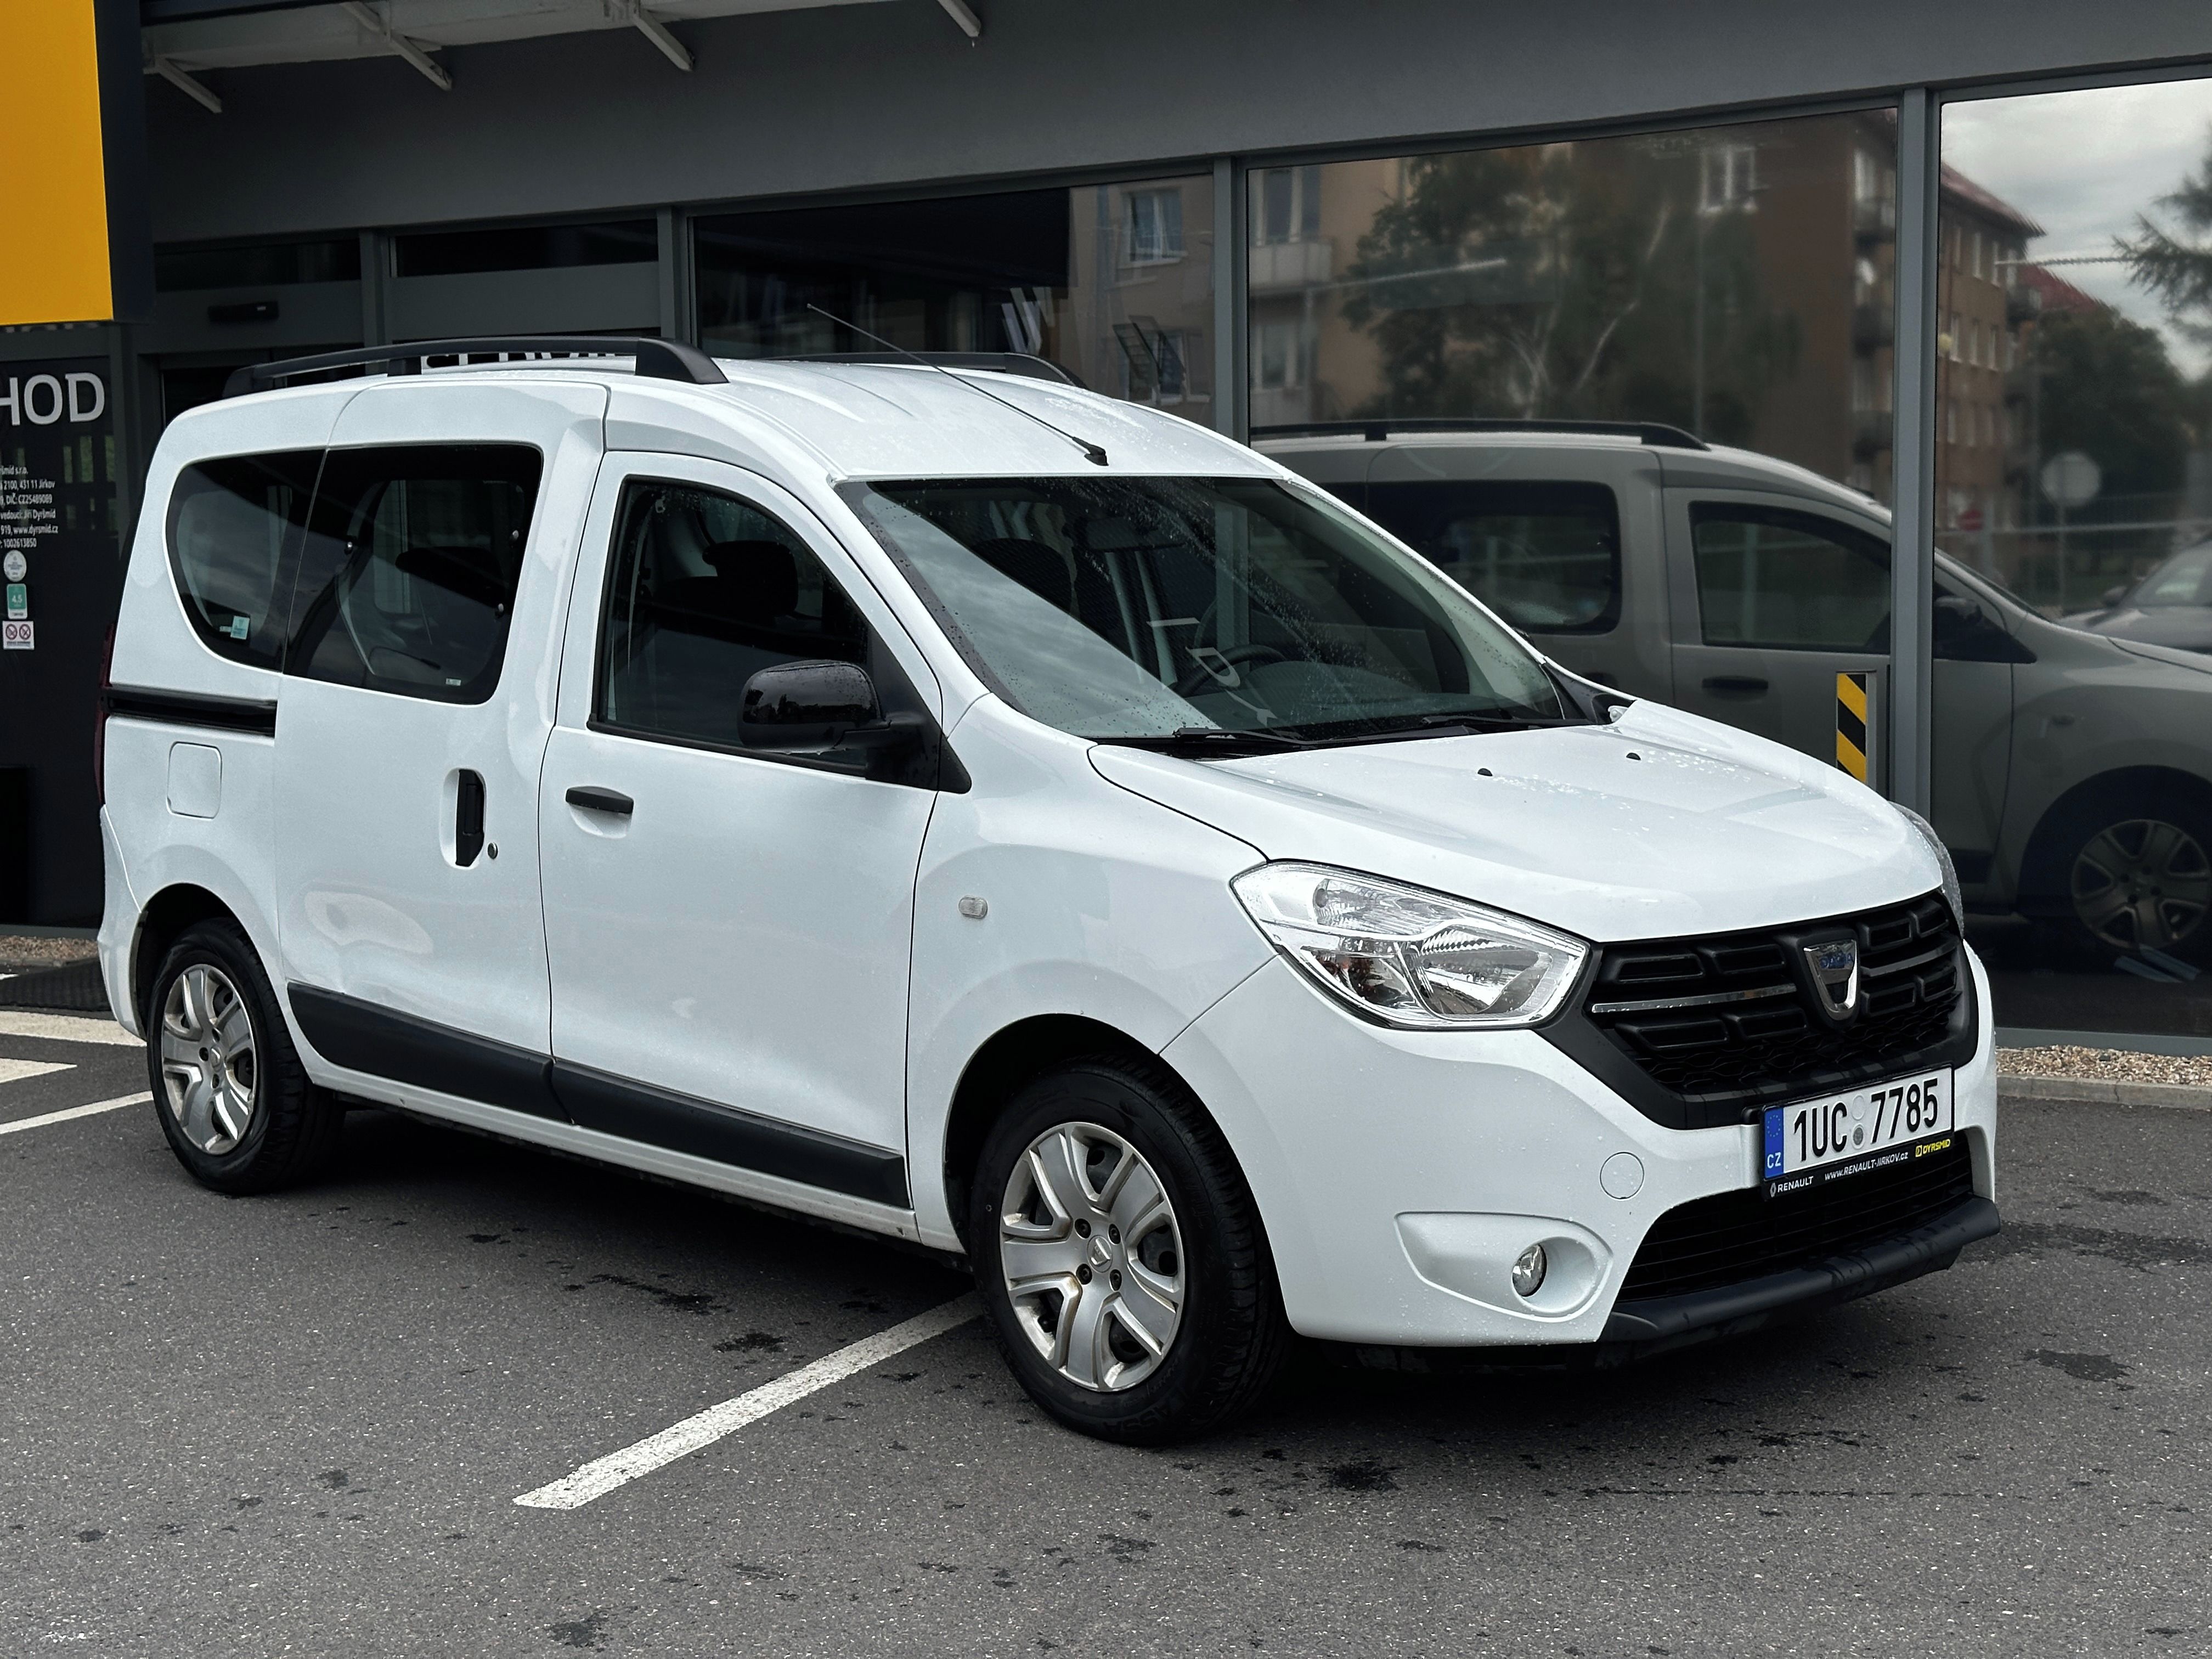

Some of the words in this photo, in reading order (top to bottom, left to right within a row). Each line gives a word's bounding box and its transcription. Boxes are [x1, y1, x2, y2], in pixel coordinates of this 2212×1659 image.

[19, 479, 30, 490] 431
[31, 479, 38, 489] 11
[1793, 1101, 1847, 1163] 1UC
[1871, 1077, 1938, 1144] 7785
[1767, 1151, 1782, 1169] CZ
[1777, 1176, 1814, 1193] RENAULT
